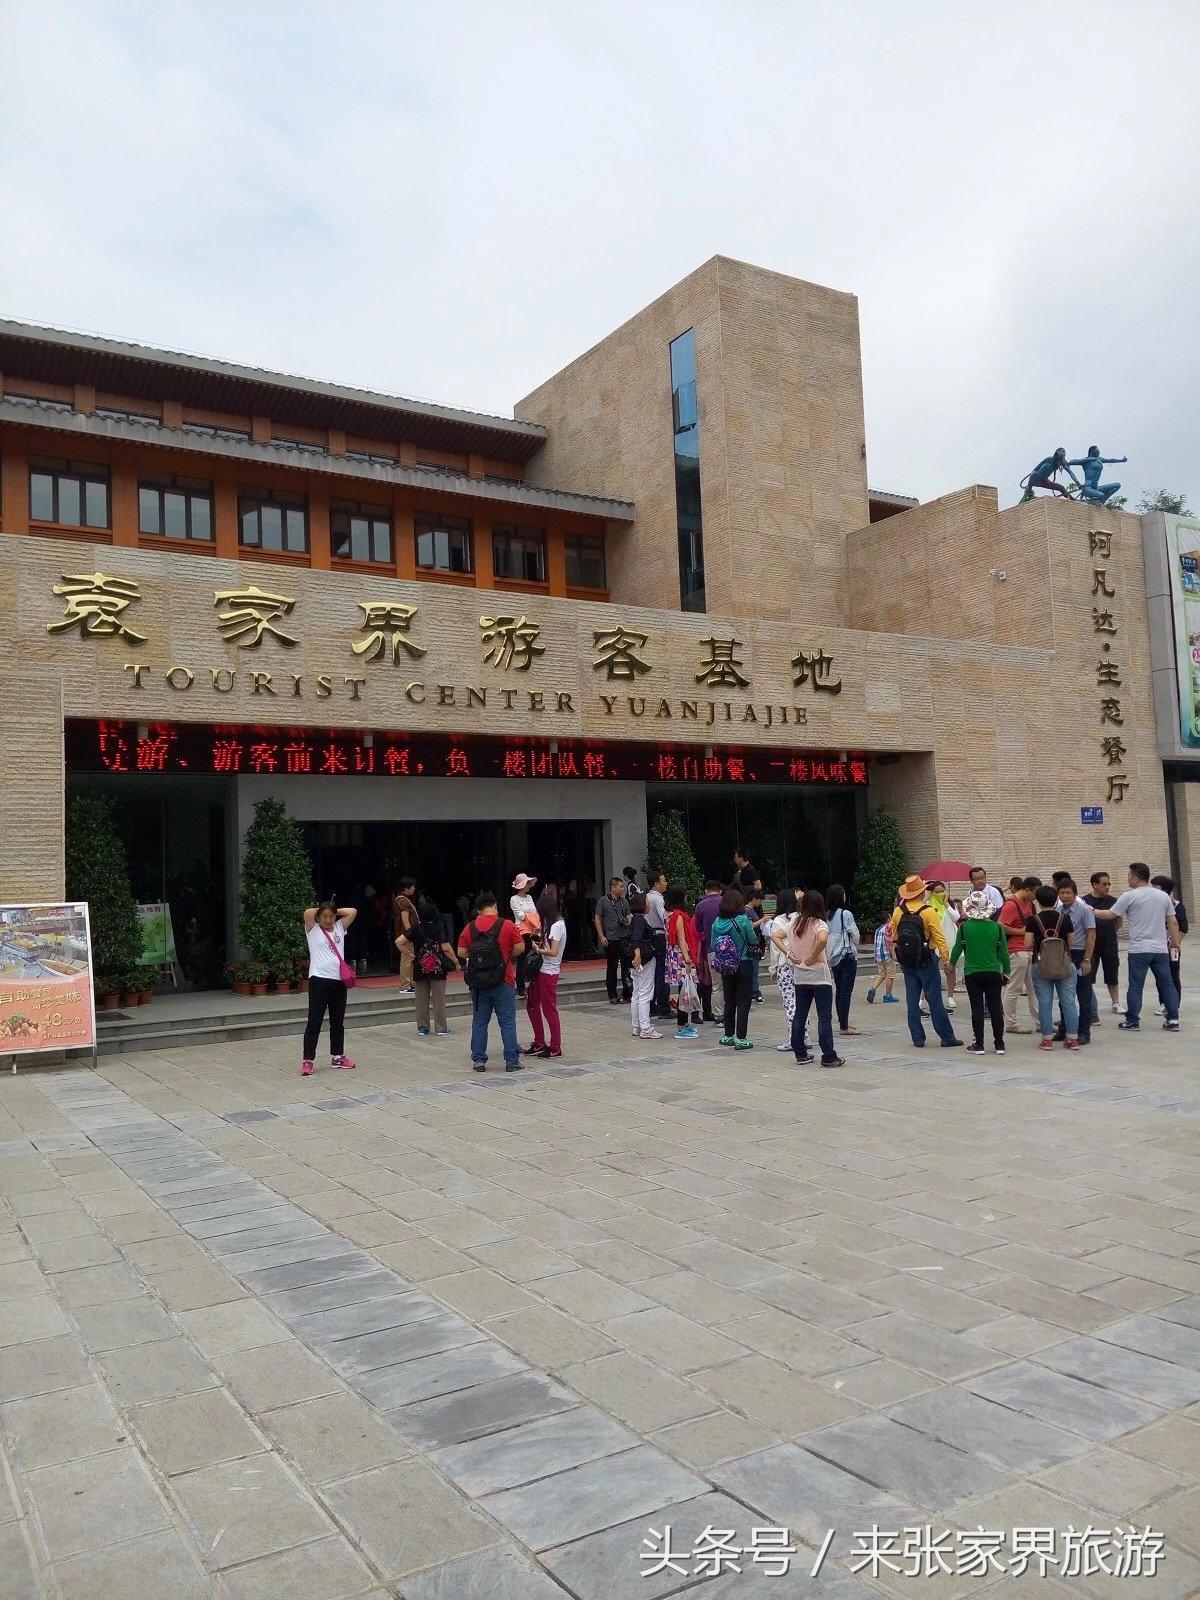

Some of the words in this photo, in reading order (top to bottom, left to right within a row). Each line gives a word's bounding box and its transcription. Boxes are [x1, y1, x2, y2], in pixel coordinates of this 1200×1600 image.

[45, 571, 843, 696] 袁家界游客基地
[123, 663, 367, 701] TOURIST
[404, 682, 576, 713] CENTER
[599, 694, 809, 729] YUANJIAJIE
